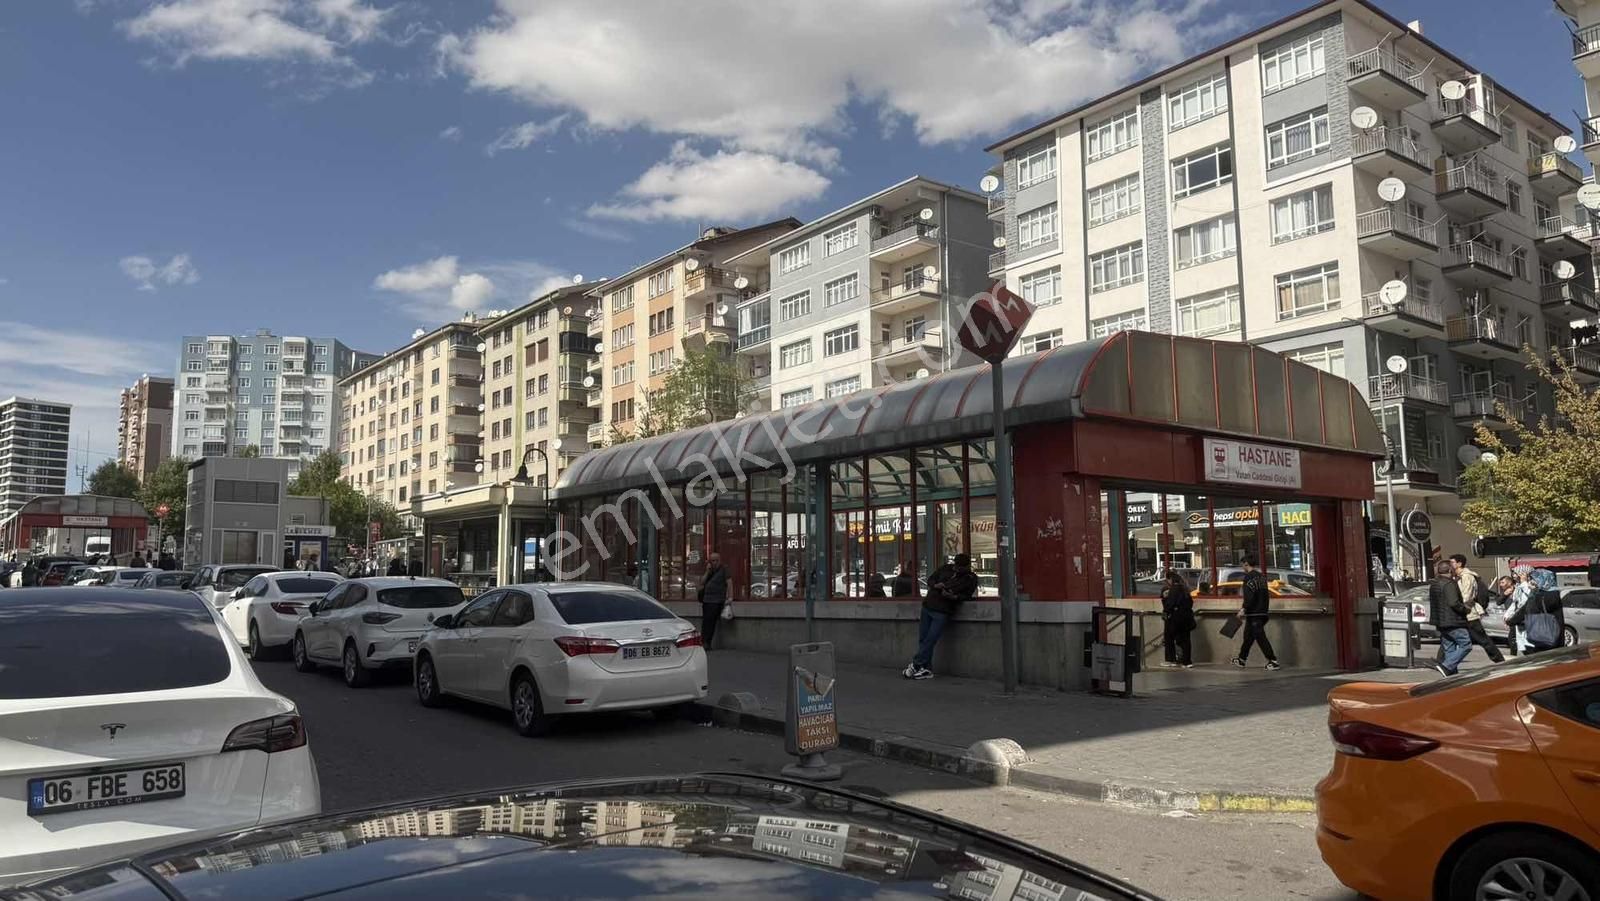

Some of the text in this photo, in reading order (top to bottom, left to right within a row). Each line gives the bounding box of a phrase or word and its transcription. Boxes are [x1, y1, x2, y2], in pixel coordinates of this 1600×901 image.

[1238, 446, 1292, 468] HASTANE
[641, 647, 651, 657] EB
[45, 780, 72, 804] 06
[87, 774, 128, 800] FBE
[142, 768, 181, 793] 658
